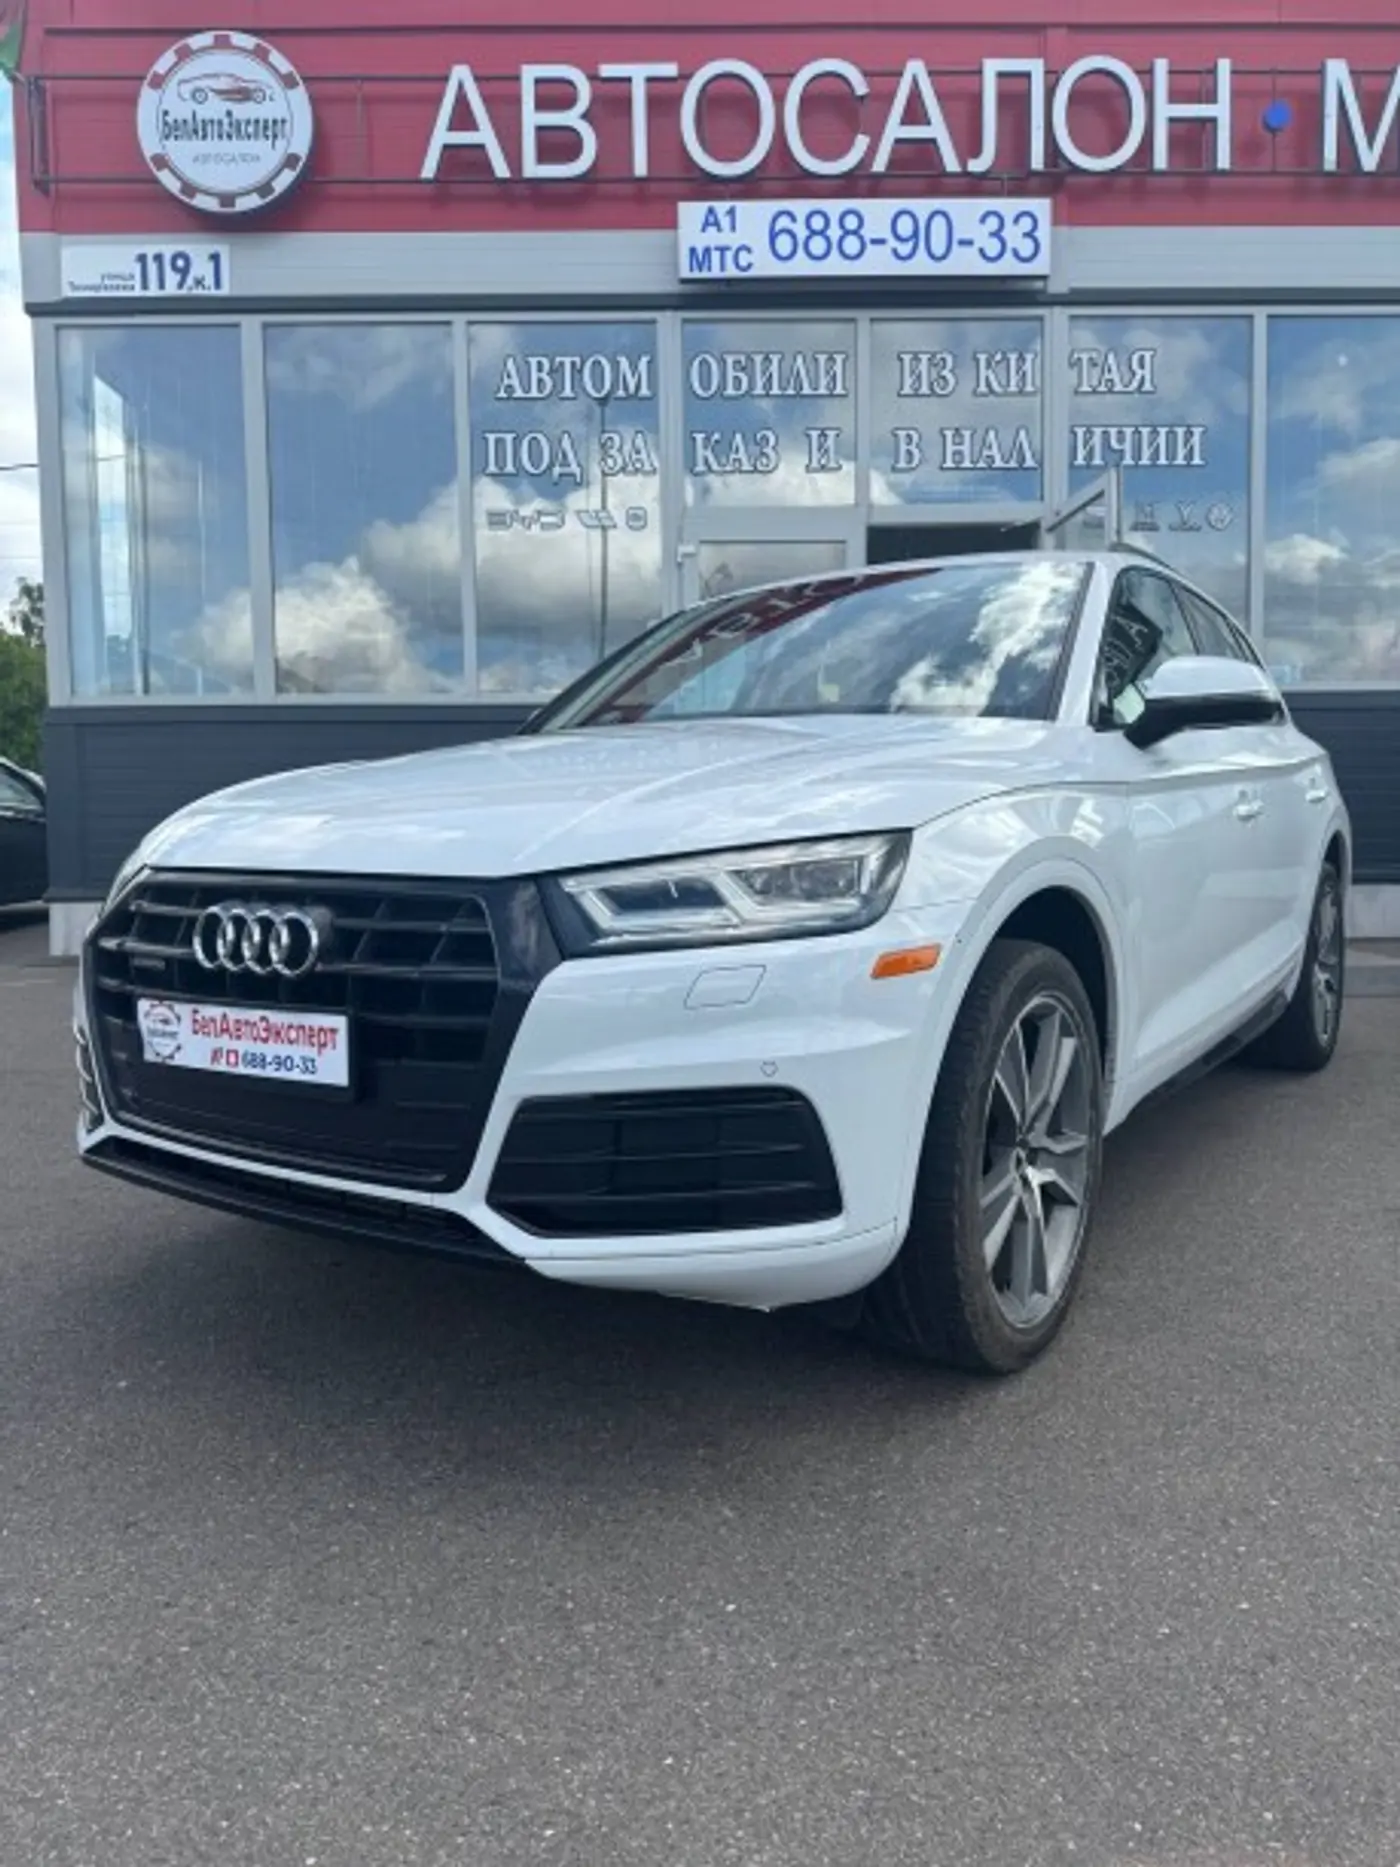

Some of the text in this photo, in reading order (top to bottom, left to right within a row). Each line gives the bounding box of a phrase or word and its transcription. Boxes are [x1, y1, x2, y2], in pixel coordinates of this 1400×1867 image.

[420, 56, 1232, 178] АВТОСАЛОН
[688, 245, 754, 273] МТС
[768, 208, 1042, 264] 688-90-33
[898, 350, 958, 397] ИЗ
[483, 431, 583, 484] ПОД
[805, 426, 845, 473] И
[892, 427, 924, 472] В
[191, 1009, 338, 1055] БелАвтоЭксперт
